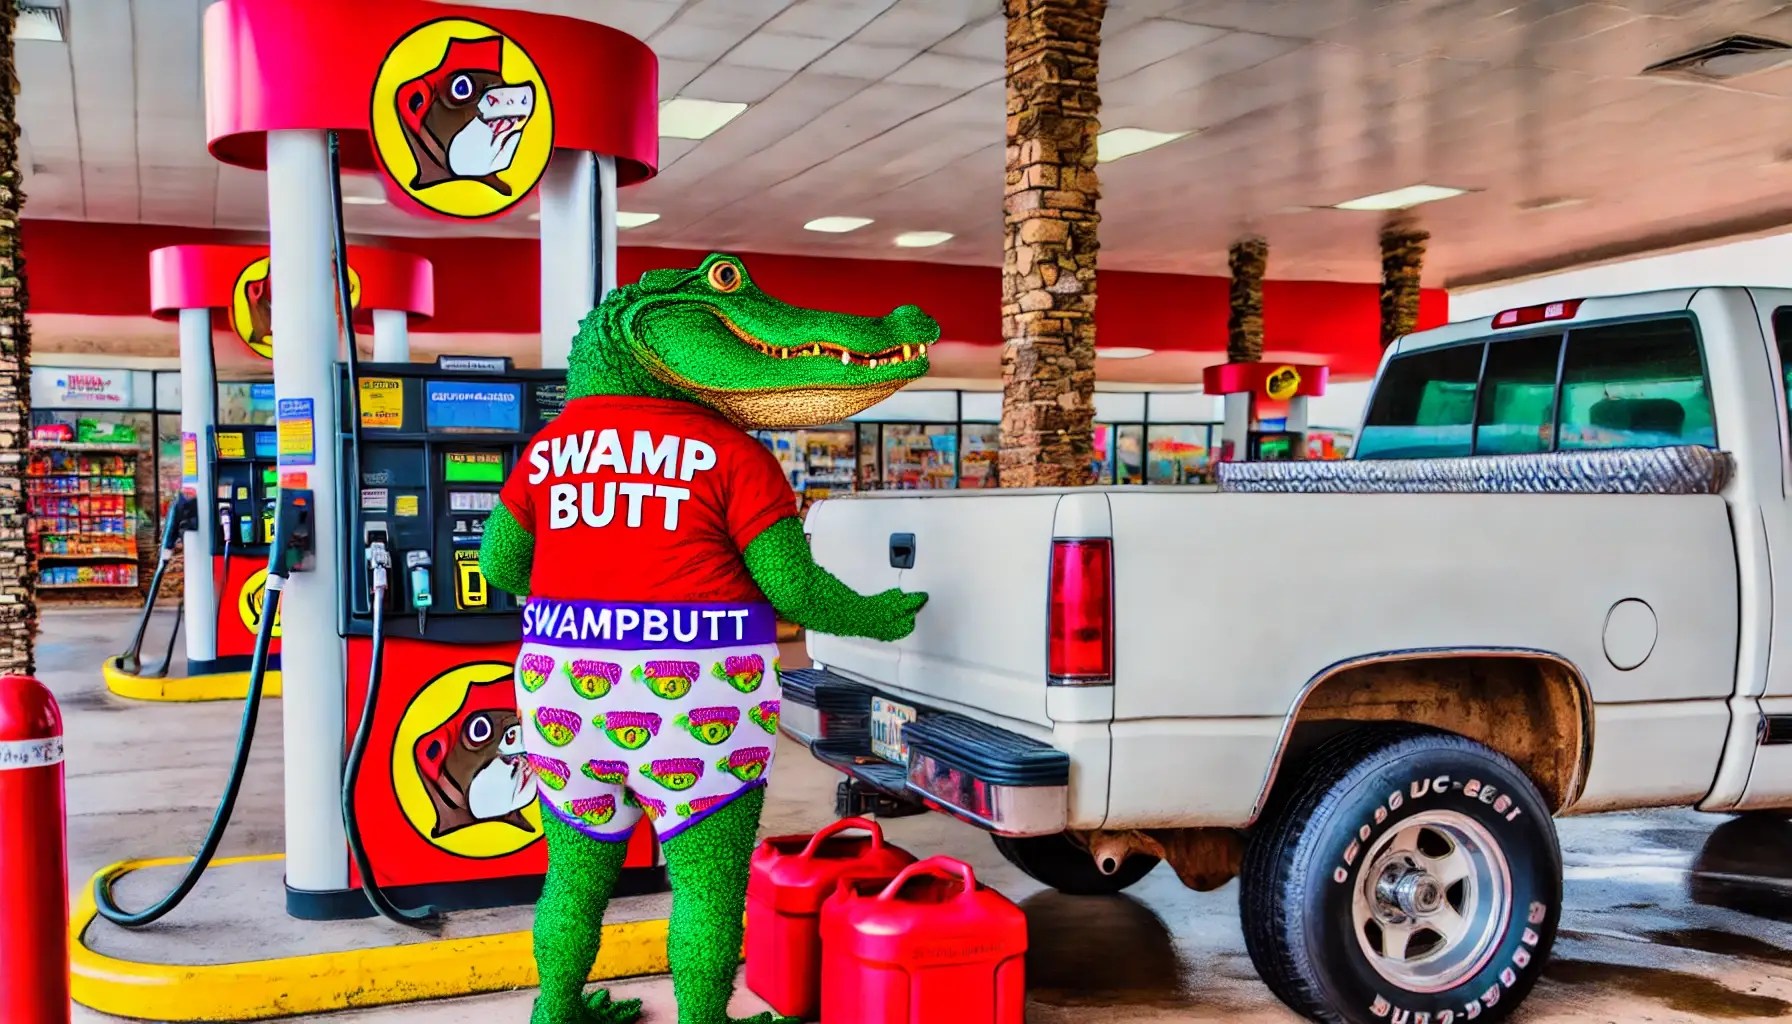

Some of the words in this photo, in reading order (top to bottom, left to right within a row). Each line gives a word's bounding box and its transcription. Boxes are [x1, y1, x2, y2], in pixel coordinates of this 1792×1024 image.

[529, 429, 716, 484] SWAMP
[550, 482, 690, 530] BUTT
[523, 602, 748, 642] SWAMPBUTT
